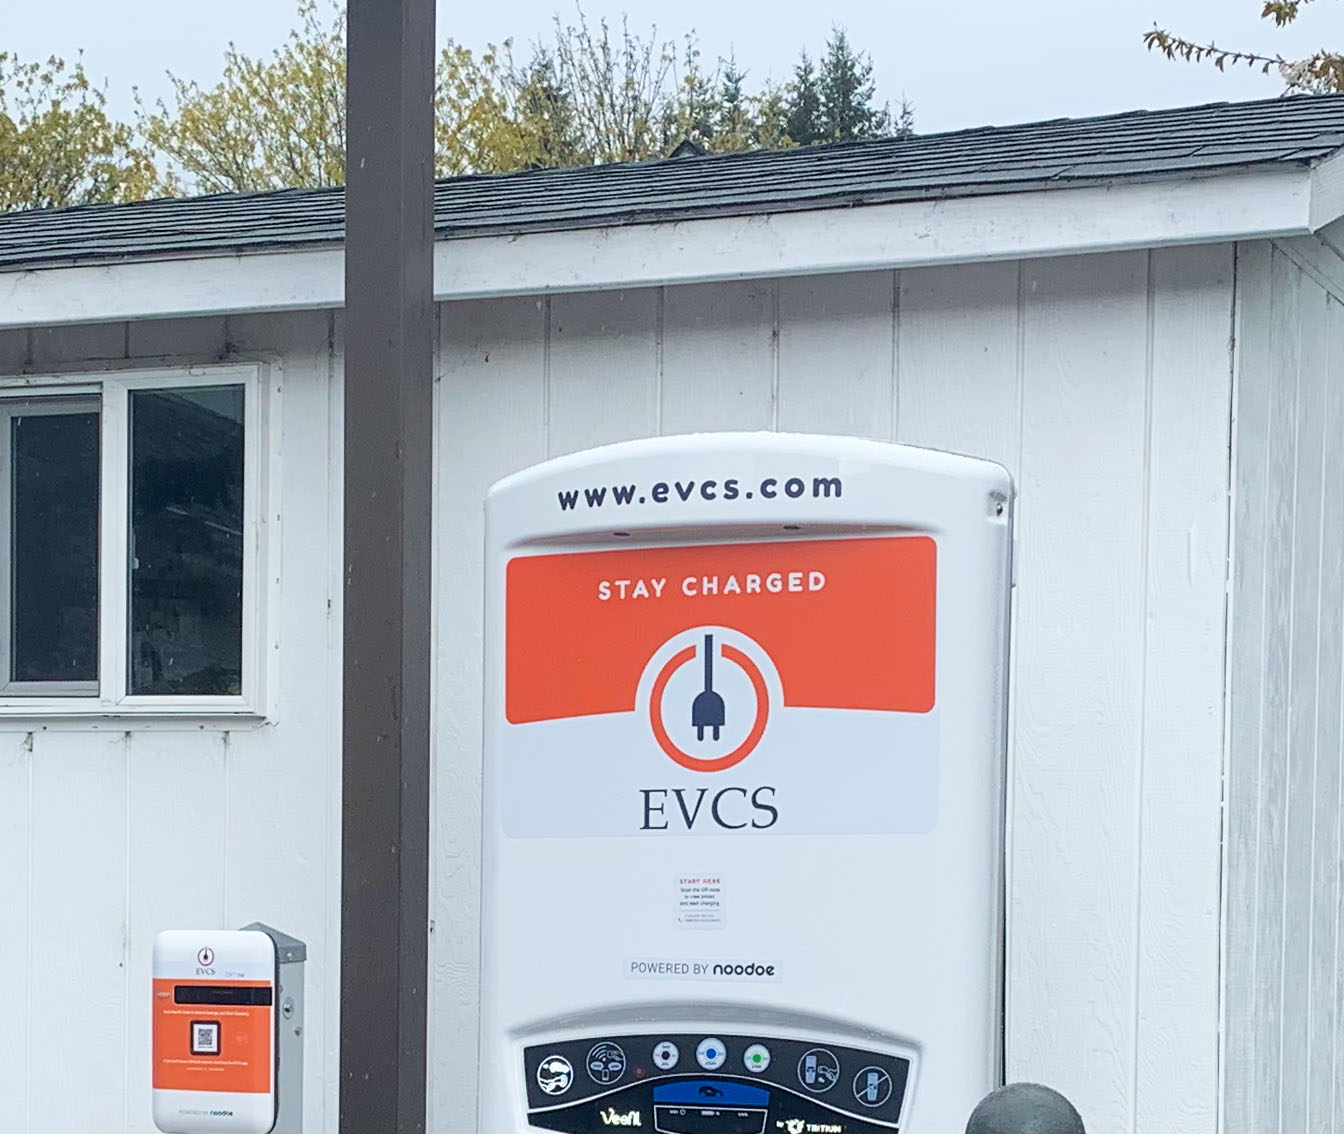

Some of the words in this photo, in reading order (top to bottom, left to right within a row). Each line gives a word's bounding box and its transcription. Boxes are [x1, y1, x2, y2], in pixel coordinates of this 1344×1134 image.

[558, 477, 843, 511] www.evcs.com
[598, 578, 667, 600] STAY
[682, 571, 826, 596] CHARGED
[640, 786, 779, 830] EVCS
[630, 962, 690, 974] POWERED
[693, 963, 709, 975] BY
[713, 963, 775, 976] noodoe
[806, 1123, 842, 1134] TRITIUM
